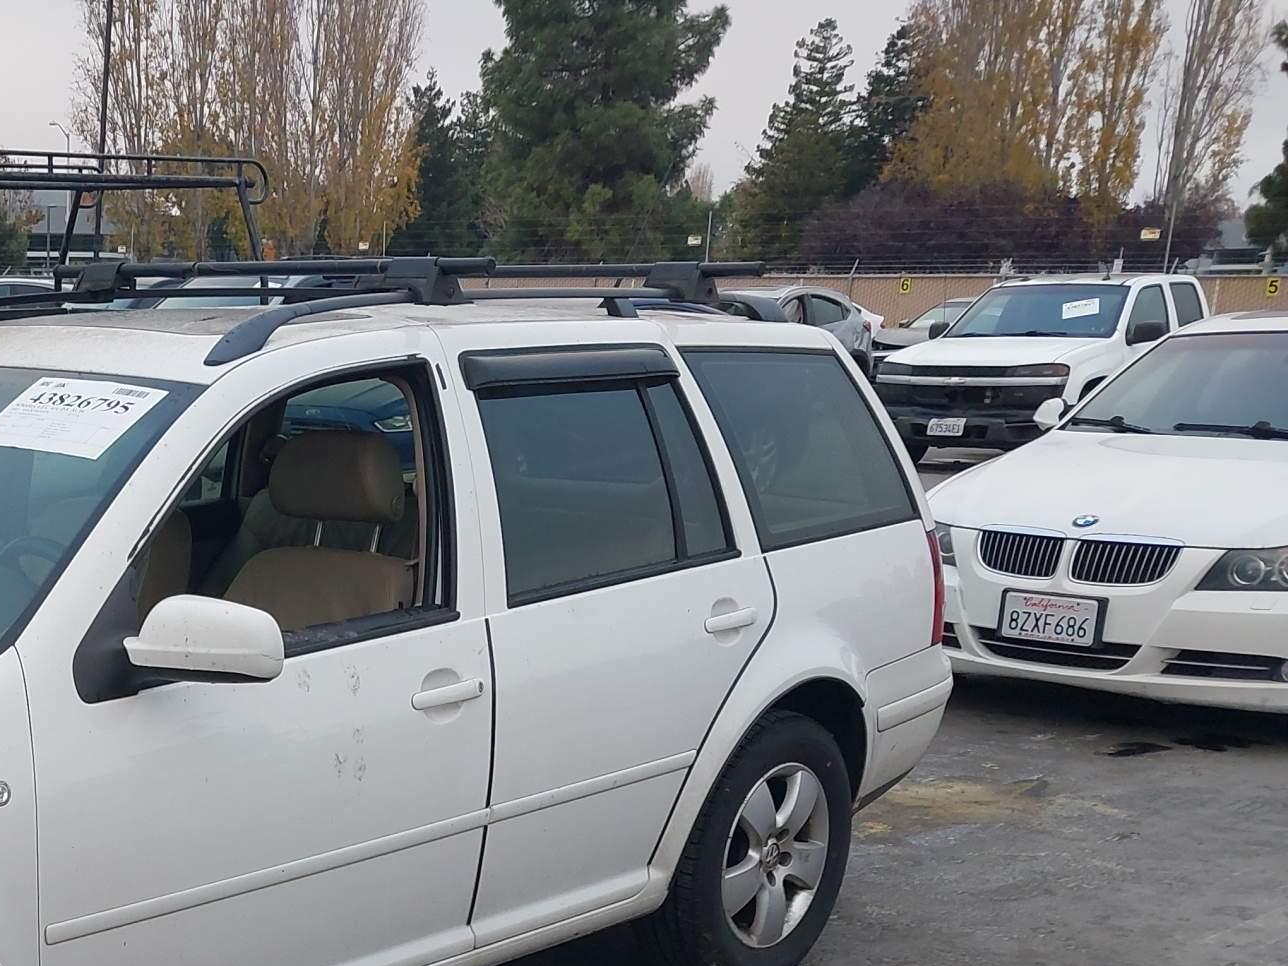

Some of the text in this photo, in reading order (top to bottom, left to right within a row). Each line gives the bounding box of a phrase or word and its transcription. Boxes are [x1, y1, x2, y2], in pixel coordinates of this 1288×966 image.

[901, 278, 909, 291] 6
[1268, 279, 1279, 294] 5
[29, 391, 136, 415] 43826795
[1023, 596, 1081, 613] California
[1008, 609, 1090, 639] 8ZXF686
